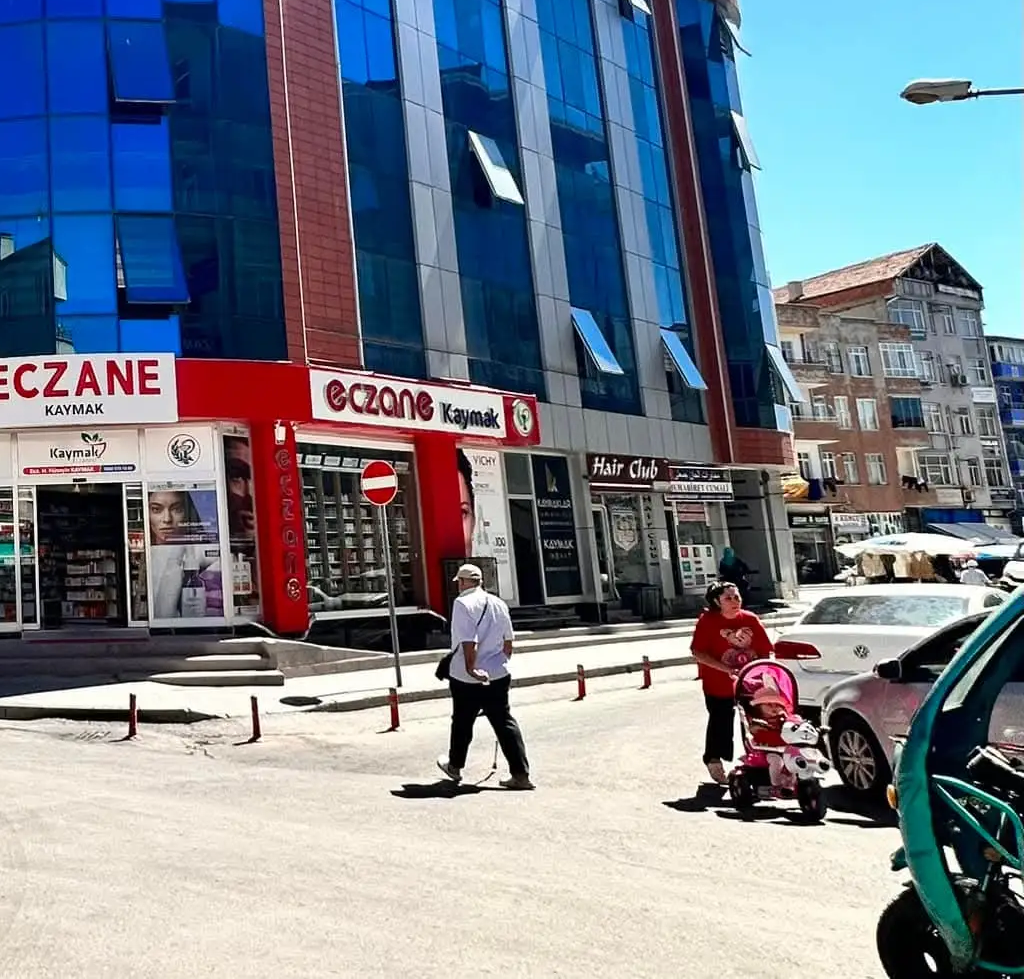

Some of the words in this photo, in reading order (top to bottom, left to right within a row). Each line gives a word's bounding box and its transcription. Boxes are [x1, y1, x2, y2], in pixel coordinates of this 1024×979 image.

[45, 403, 104, 416] KAYMAK
[326, 379, 434, 421] eczane
[441, 402, 500, 430] Kaymak
[49, 444, 98, 460] Kaymak
[472, 455, 496, 466] VICHY
[593, 457, 624, 476] Hair
[629, 458, 658, 480] Club
